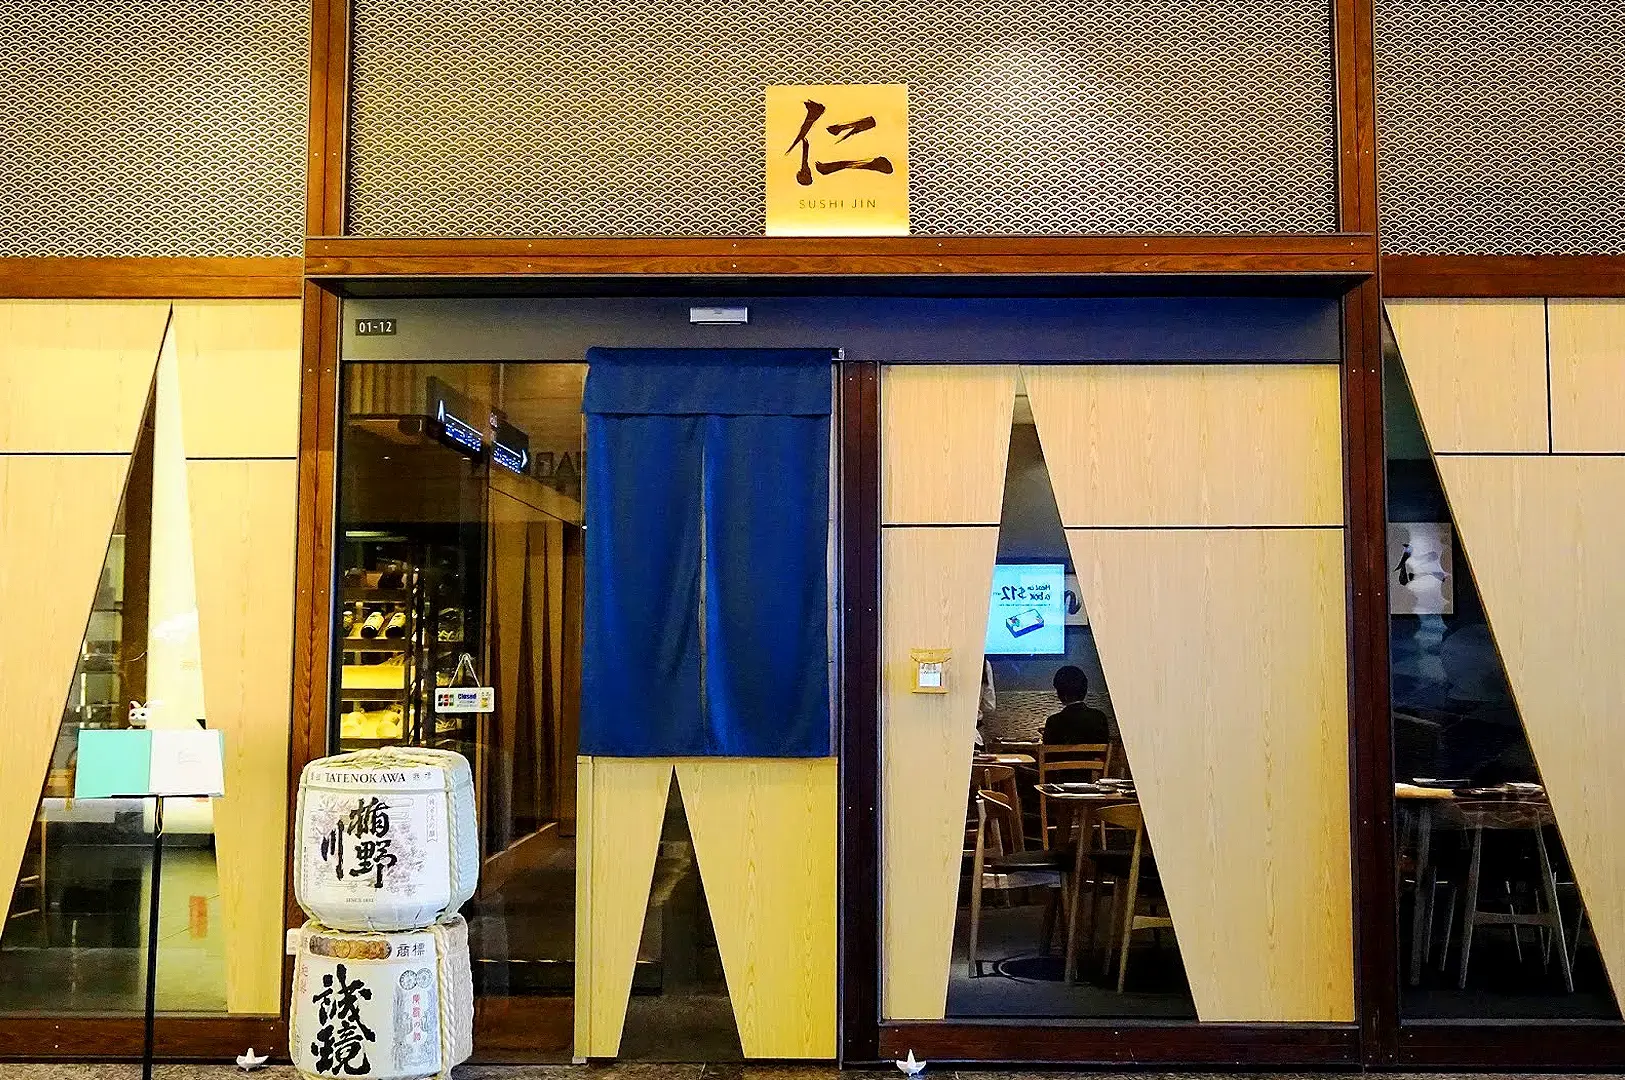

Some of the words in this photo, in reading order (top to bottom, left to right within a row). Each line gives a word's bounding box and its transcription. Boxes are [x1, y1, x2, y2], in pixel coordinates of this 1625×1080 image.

[784, 99, 894, 186] 仁
[799, 199, 844, 209] SUSHI
[851, 199, 876, 208] JIN
[359, 321, 392, 333] 01-12
[325, 772, 406, 783] TATENOKAWA
[396, 942, 426, 958] 商標
